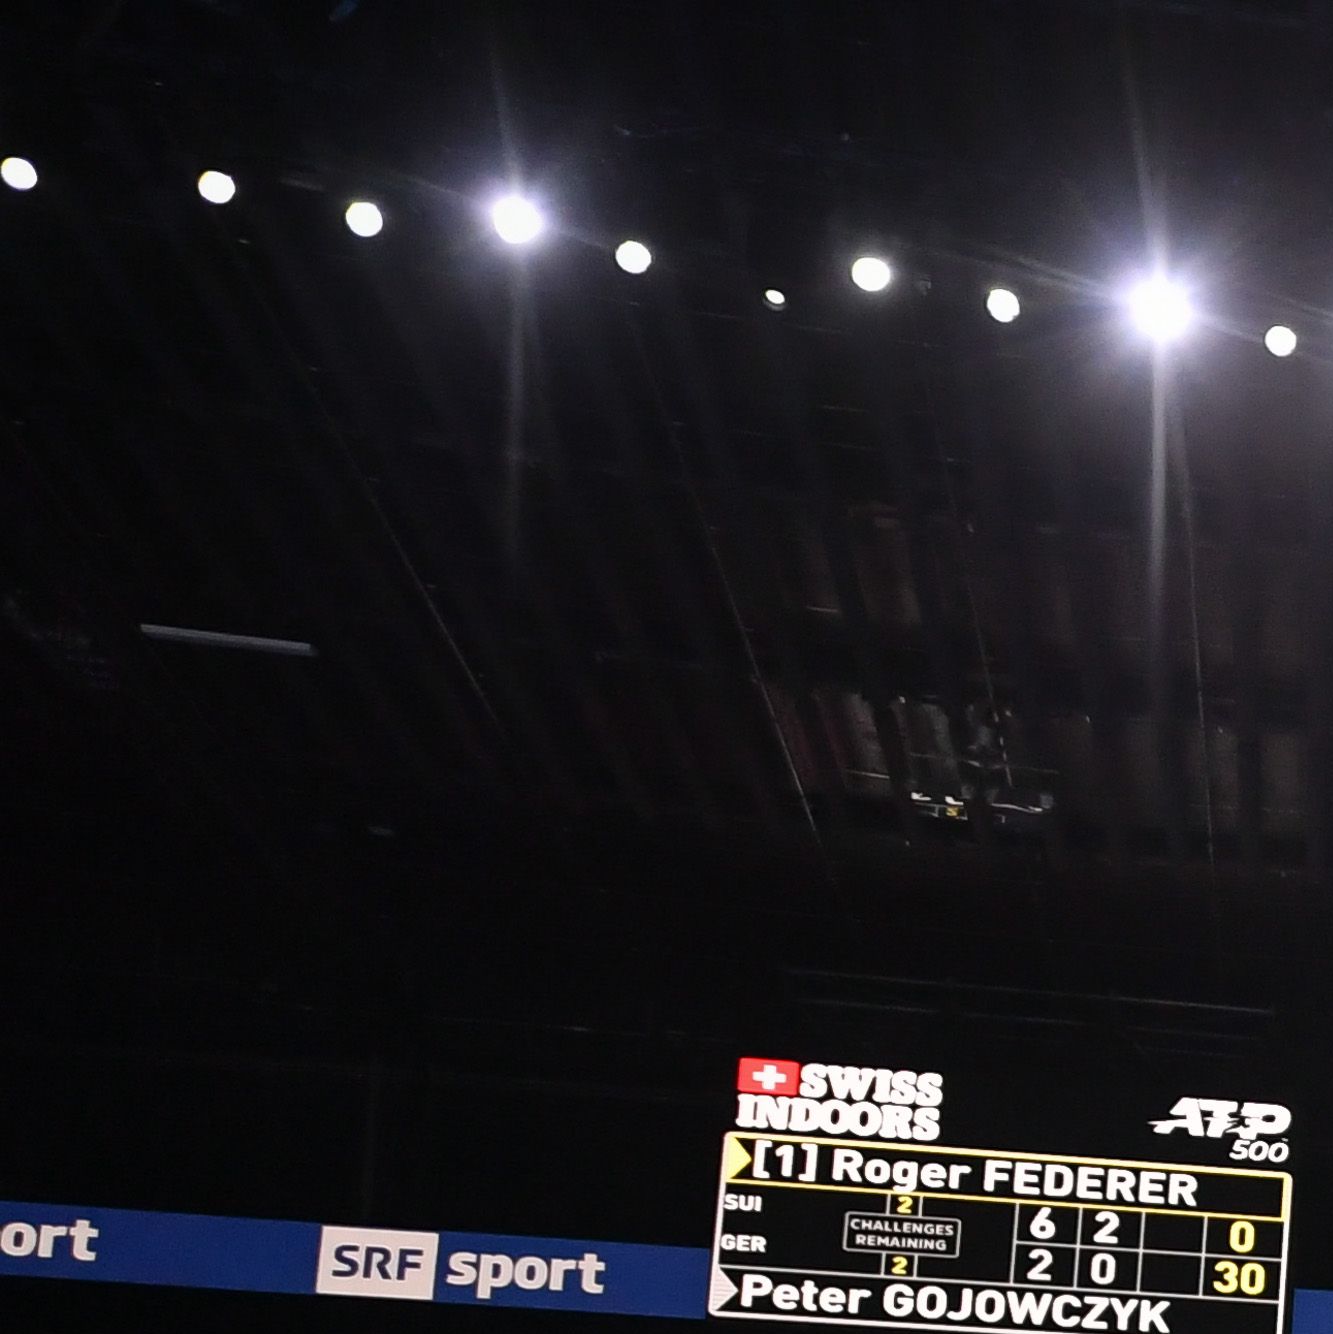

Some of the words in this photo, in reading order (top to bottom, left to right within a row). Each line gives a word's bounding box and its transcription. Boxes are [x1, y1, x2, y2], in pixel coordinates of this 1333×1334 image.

[799, 1063, 943, 1107] SWISS
[735, 1094, 940, 1141] INDOORS
[1148, 1097, 1291, 1140] ATP
[752, 1139, 819, 1182] [1]
[831, 1148, 972, 1192] Roger
[983, 1158, 1198, 1206] FEDERER
[1229, 1140, 1290, 1163] 500
[722, 1193, 763, 1212] SUI
[897, 1196, 913, 1213] 2
[720, 1234, 767, 1253] GER
[850, 1218, 954, 1236] CHALLENGES
[855, 1234, 947, 1251] REMAINING
[1029, 1207, 1056, 1239] 6
[1093, 1211, 1120, 1244] 2
[1229, 1221, 1255, 1253] 0
[332, 1243, 424, 1281] SRF
[446, 1250, 605, 1298] sport
[891, 1257, 907, 1275] 2
[1027, 1248, 1053, 1281] 2
[1090, 1253, 1116, 1285] 0
[1213, 1261, 1266, 1295] 30
[740, 1273, 872, 1314] Peter
[883, 1283, 1171, 1333] GOJOWCZYK
